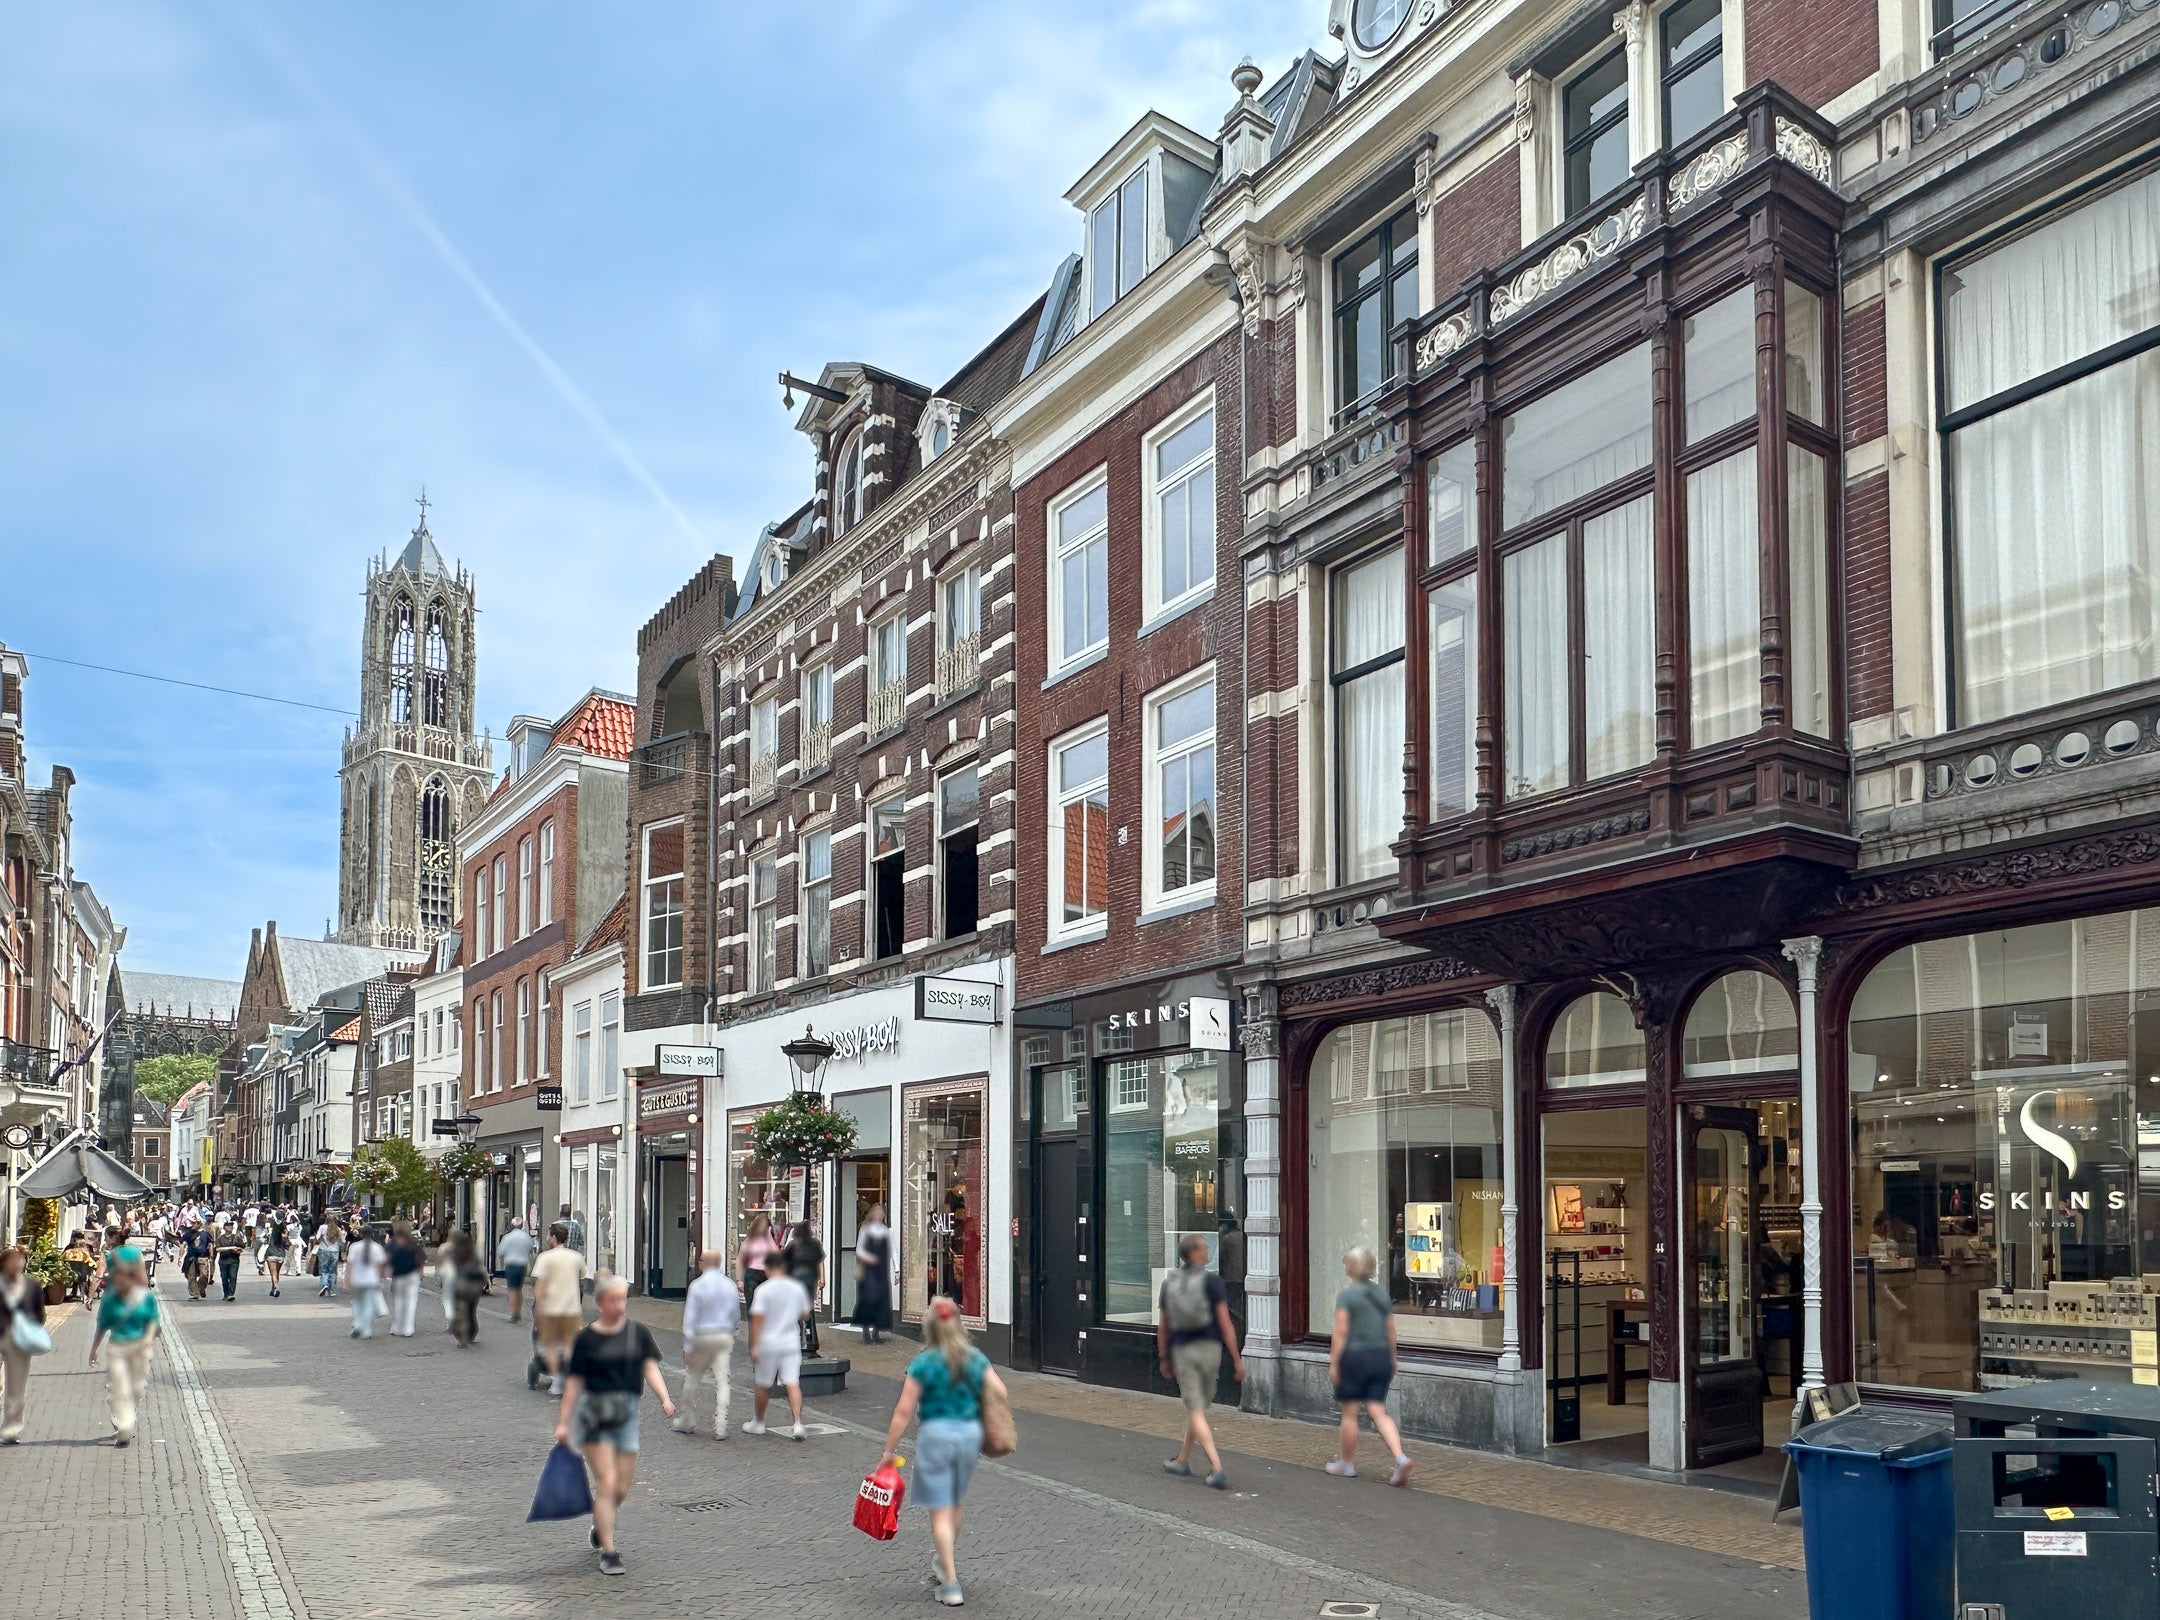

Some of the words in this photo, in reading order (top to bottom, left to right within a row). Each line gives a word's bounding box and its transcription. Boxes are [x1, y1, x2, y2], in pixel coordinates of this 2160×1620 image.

[1109, 1002, 1190, 1030] SKINS
[1979, 1191, 2126, 1210] SKINS
[932, 1213, 954, 1233] SALE
